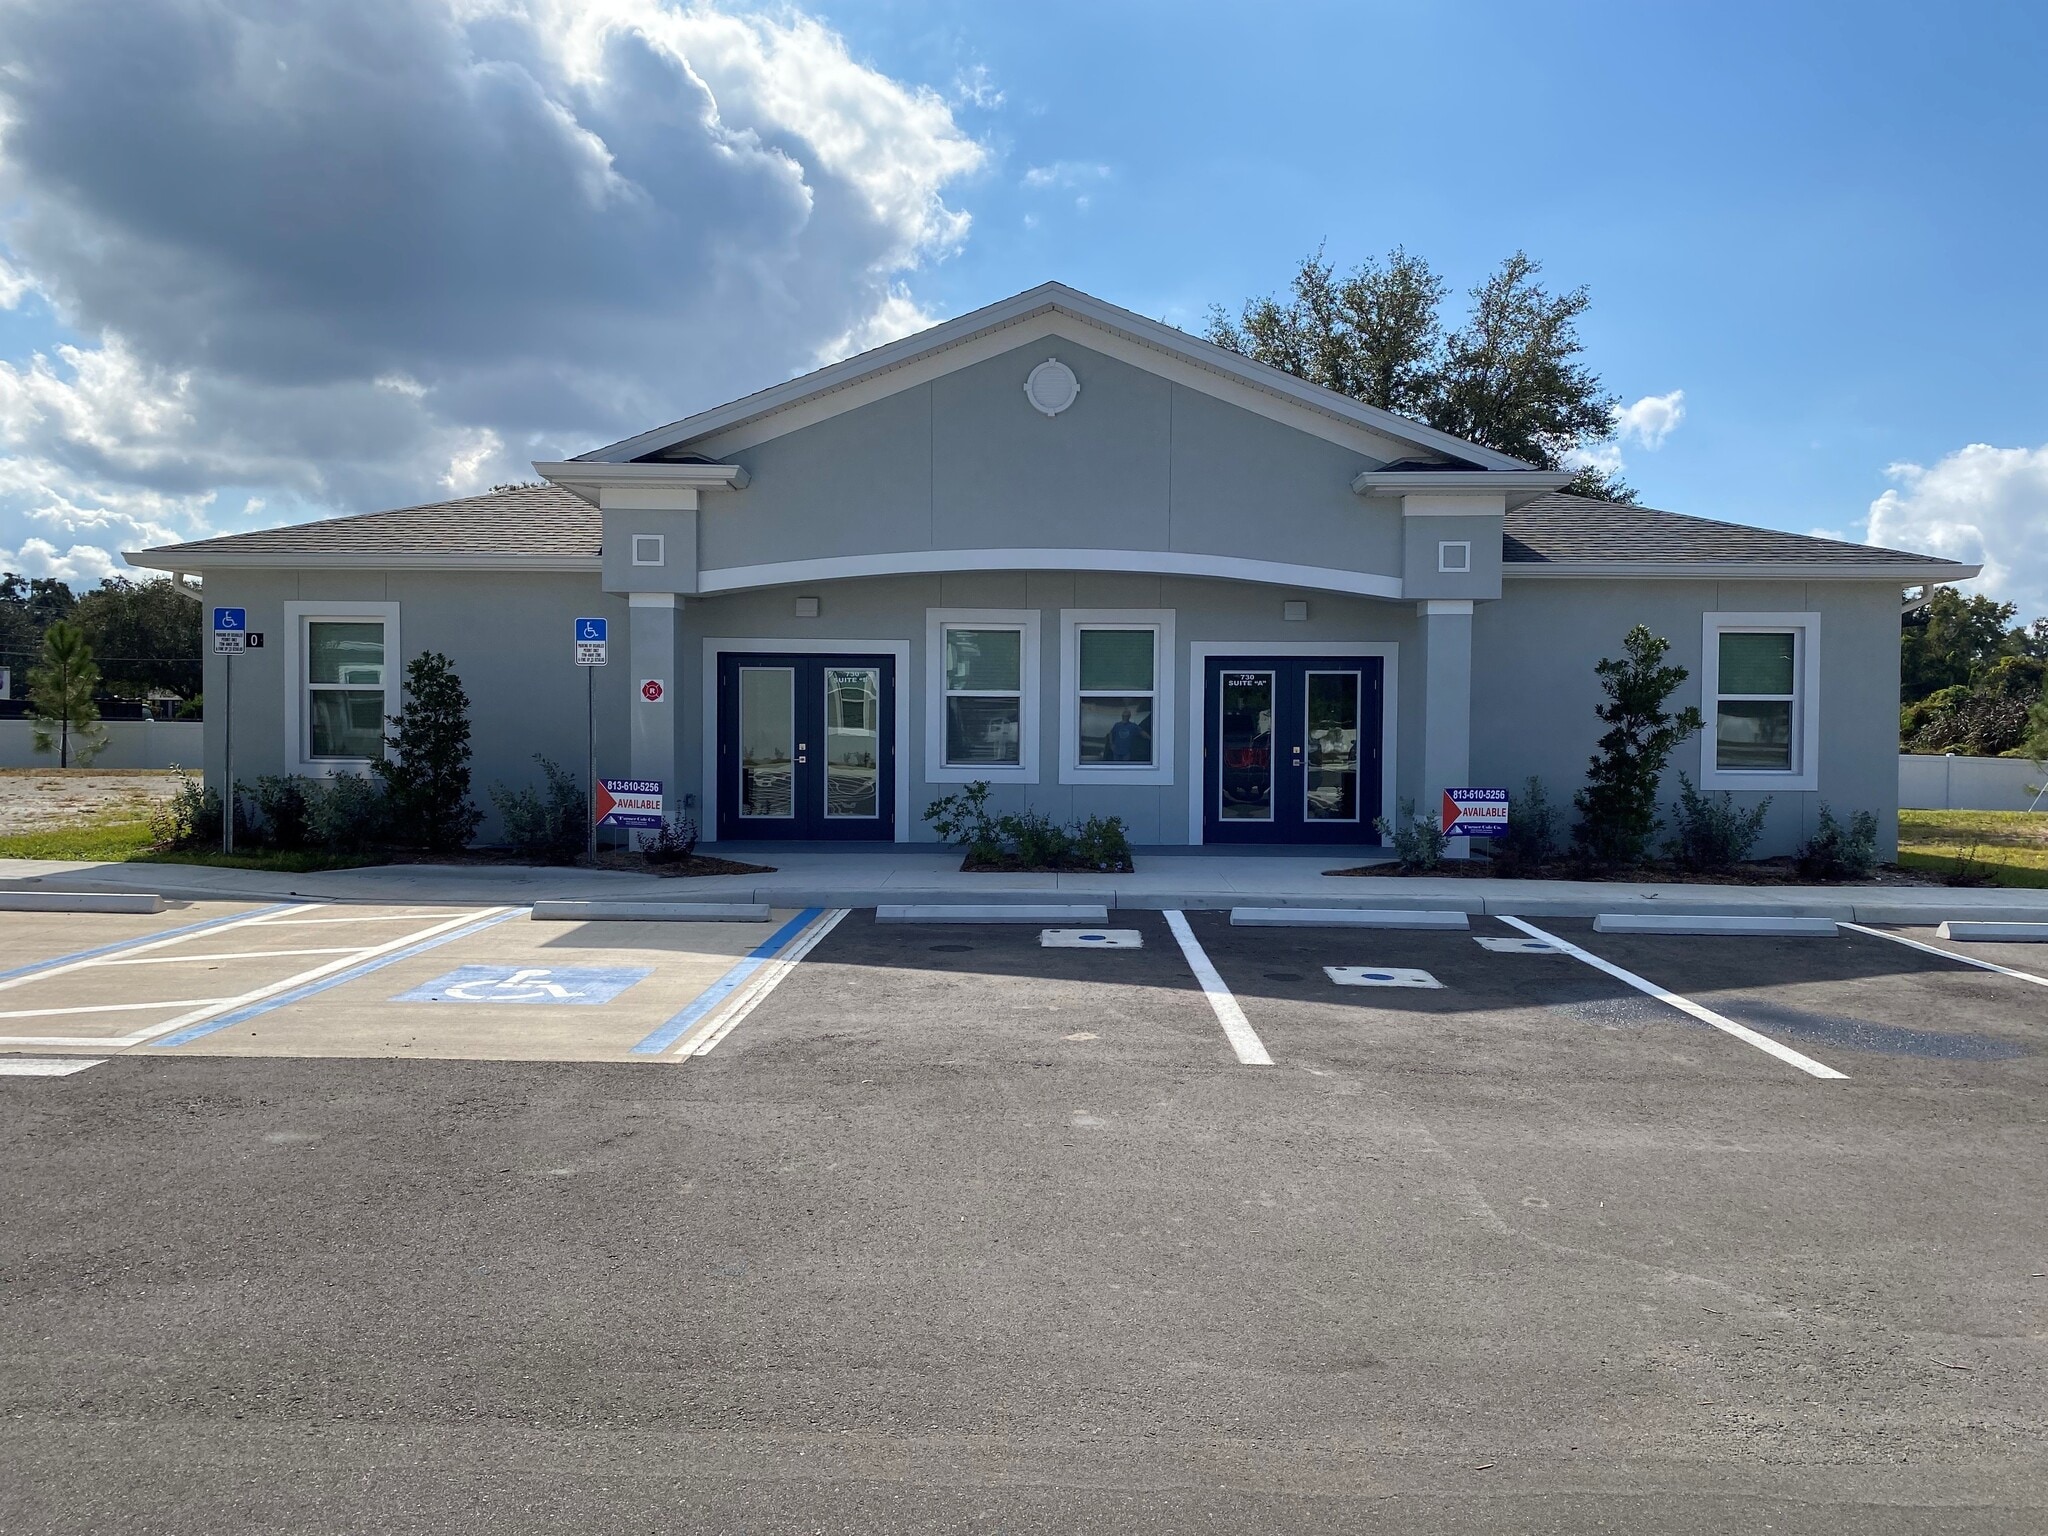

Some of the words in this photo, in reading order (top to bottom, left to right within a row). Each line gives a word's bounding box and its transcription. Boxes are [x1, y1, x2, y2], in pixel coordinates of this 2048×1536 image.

[607, 781, 659, 792] 813-610-5256
[1453, 790, 1505, 799] 813-610-5256
[617, 799, 660, 809] AVAILABLE
[1463, 808, 1507, 817] AVAILABLE
